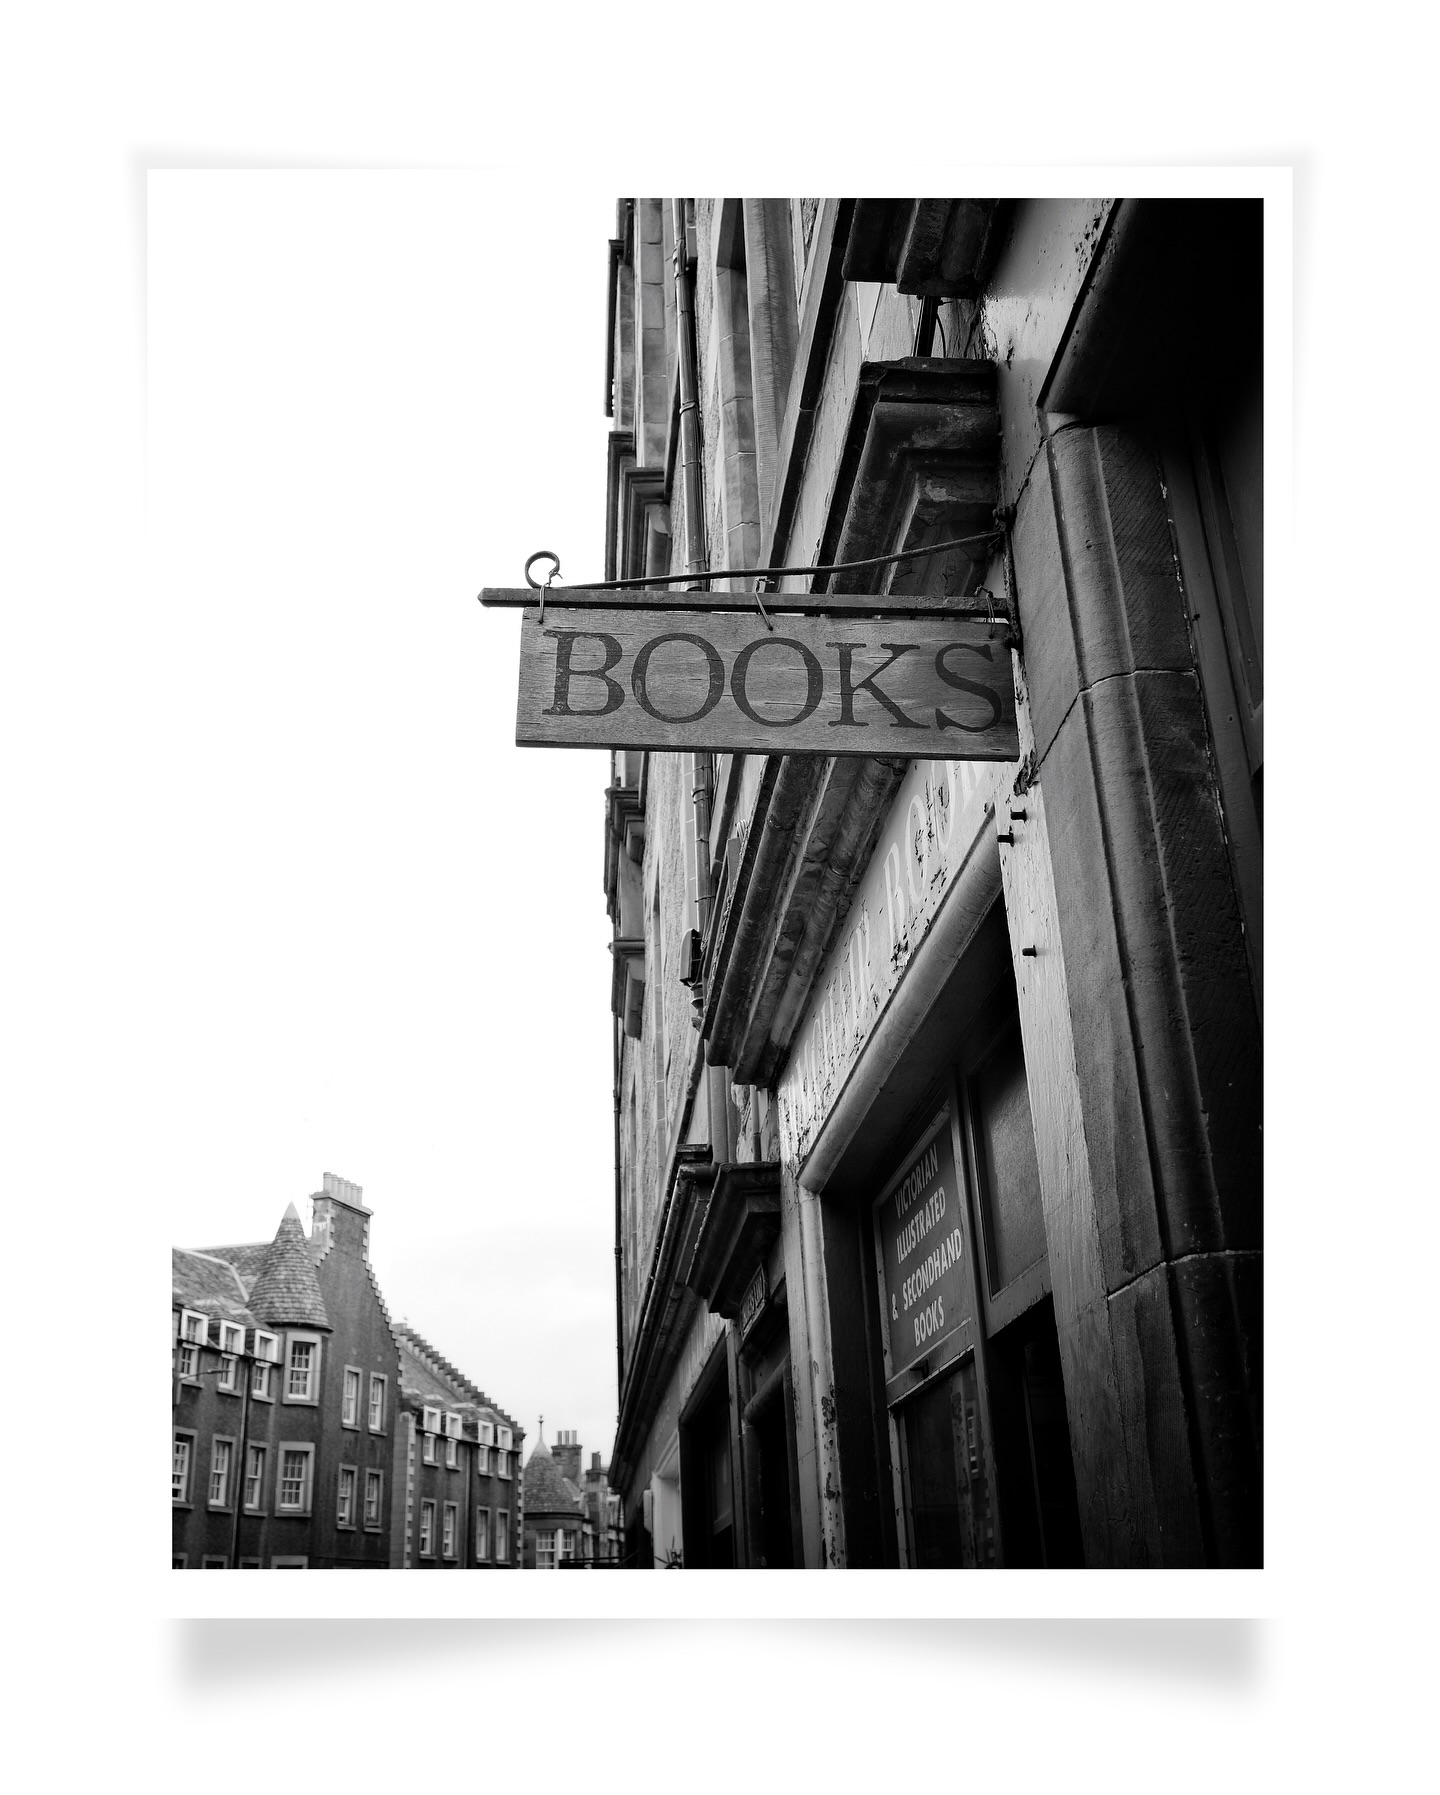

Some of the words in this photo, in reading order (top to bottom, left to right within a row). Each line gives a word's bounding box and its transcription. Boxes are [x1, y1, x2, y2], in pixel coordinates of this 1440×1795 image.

[542, 629, 1001, 733] BOOKS
[894, 1143, 939, 1219] VICTORIAN
[896, 1186, 946, 1265] ILLUSTRATED
[892, 1293, 899, 1321] &
[903, 1228, 962, 1311] SECONDHAND
[914, 1295, 945, 1346] BOOKS
